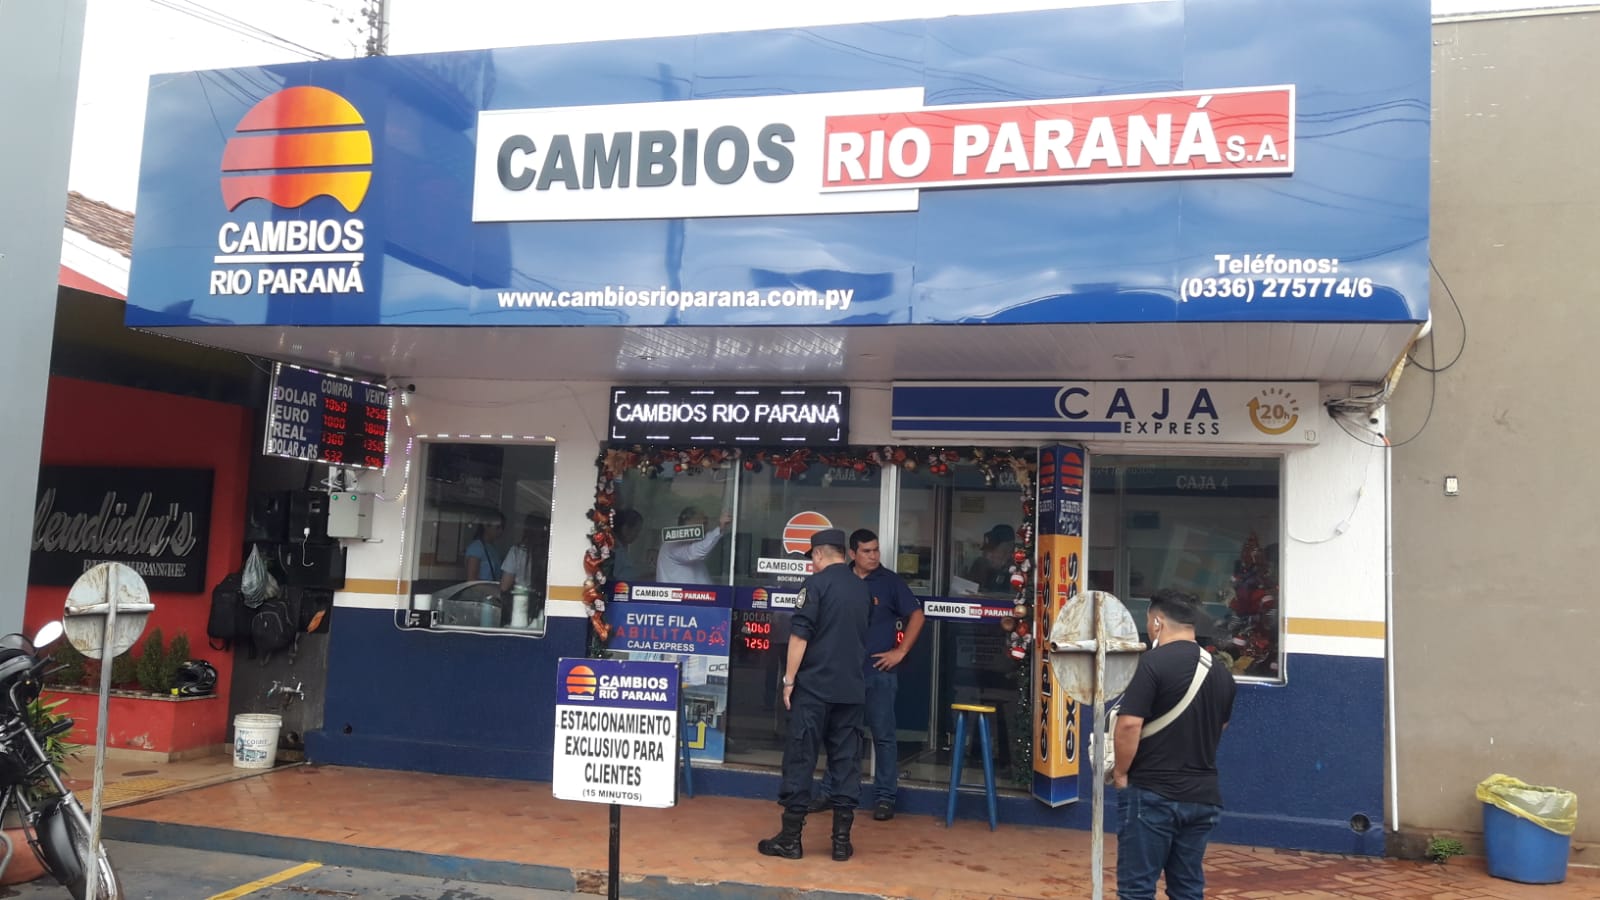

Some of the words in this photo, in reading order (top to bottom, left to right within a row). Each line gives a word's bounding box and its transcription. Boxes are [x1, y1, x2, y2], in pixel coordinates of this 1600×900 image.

[497, 123, 795, 191] CAMBIOS
[828, 128, 930, 182] RIO
[952, 96, 1221, 175] PARANÁ
[1225, 135, 1287, 163] S.A.
[218, 218, 365, 254] CAMBIOS
[1215, 254, 1338, 274] Teléfonos:
[209, 268, 252, 295] RIO
[256, 260, 364, 295] PARANÁ
[498, 286, 854, 312] www.cambiosrioparana.com.py
[1181, 278, 1253, 302] (0336)
[1262, 278, 1373, 298] 275774/6
[276, 386, 318, 407] DOLAR
[321, 379, 353, 399] COMPRA
[275, 404, 309, 423] EURO
[616, 404, 707, 422] CAMBIOS
[713, 404, 749, 422] RIO
[755, 404, 840, 423] PARANA
[1058, 387, 1219, 421] CAJA
[272, 421, 307, 441] REAL
[1124, 422, 1219, 436] EXPRESS
[271, 437, 299, 458] DOLAR
[1176, 476, 1216, 489] CAJA
[665, 527, 701, 539] ABIERTO
[759, 561, 804, 571] CAMBIOS
[635, 588, 669, 598] CAMBIOS
[774, 595, 796, 605] CAMB
[927, 604, 966, 614] CAMBIOS
[627, 613, 665, 626] EVITE
[668, 615, 698, 628] FILA
[627, 640, 651, 650] CAJA
[653, 642, 695, 652] EXPRESS
[600, 675, 669, 689] CAMBIOS
[599, 690, 618, 699] RIO
[621, 691, 668, 702] PARANA
[561, 710, 671, 735] ESTACIONAMIENTO
[565, 736, 630, 759] EXCLUSIVO
[633, 740, 664, 762] PARA
[584, 762, 642, 786] CLIENTES
[582, 788, 596, 798] (15
[598, 789, 643, 801] MINUTOS)
